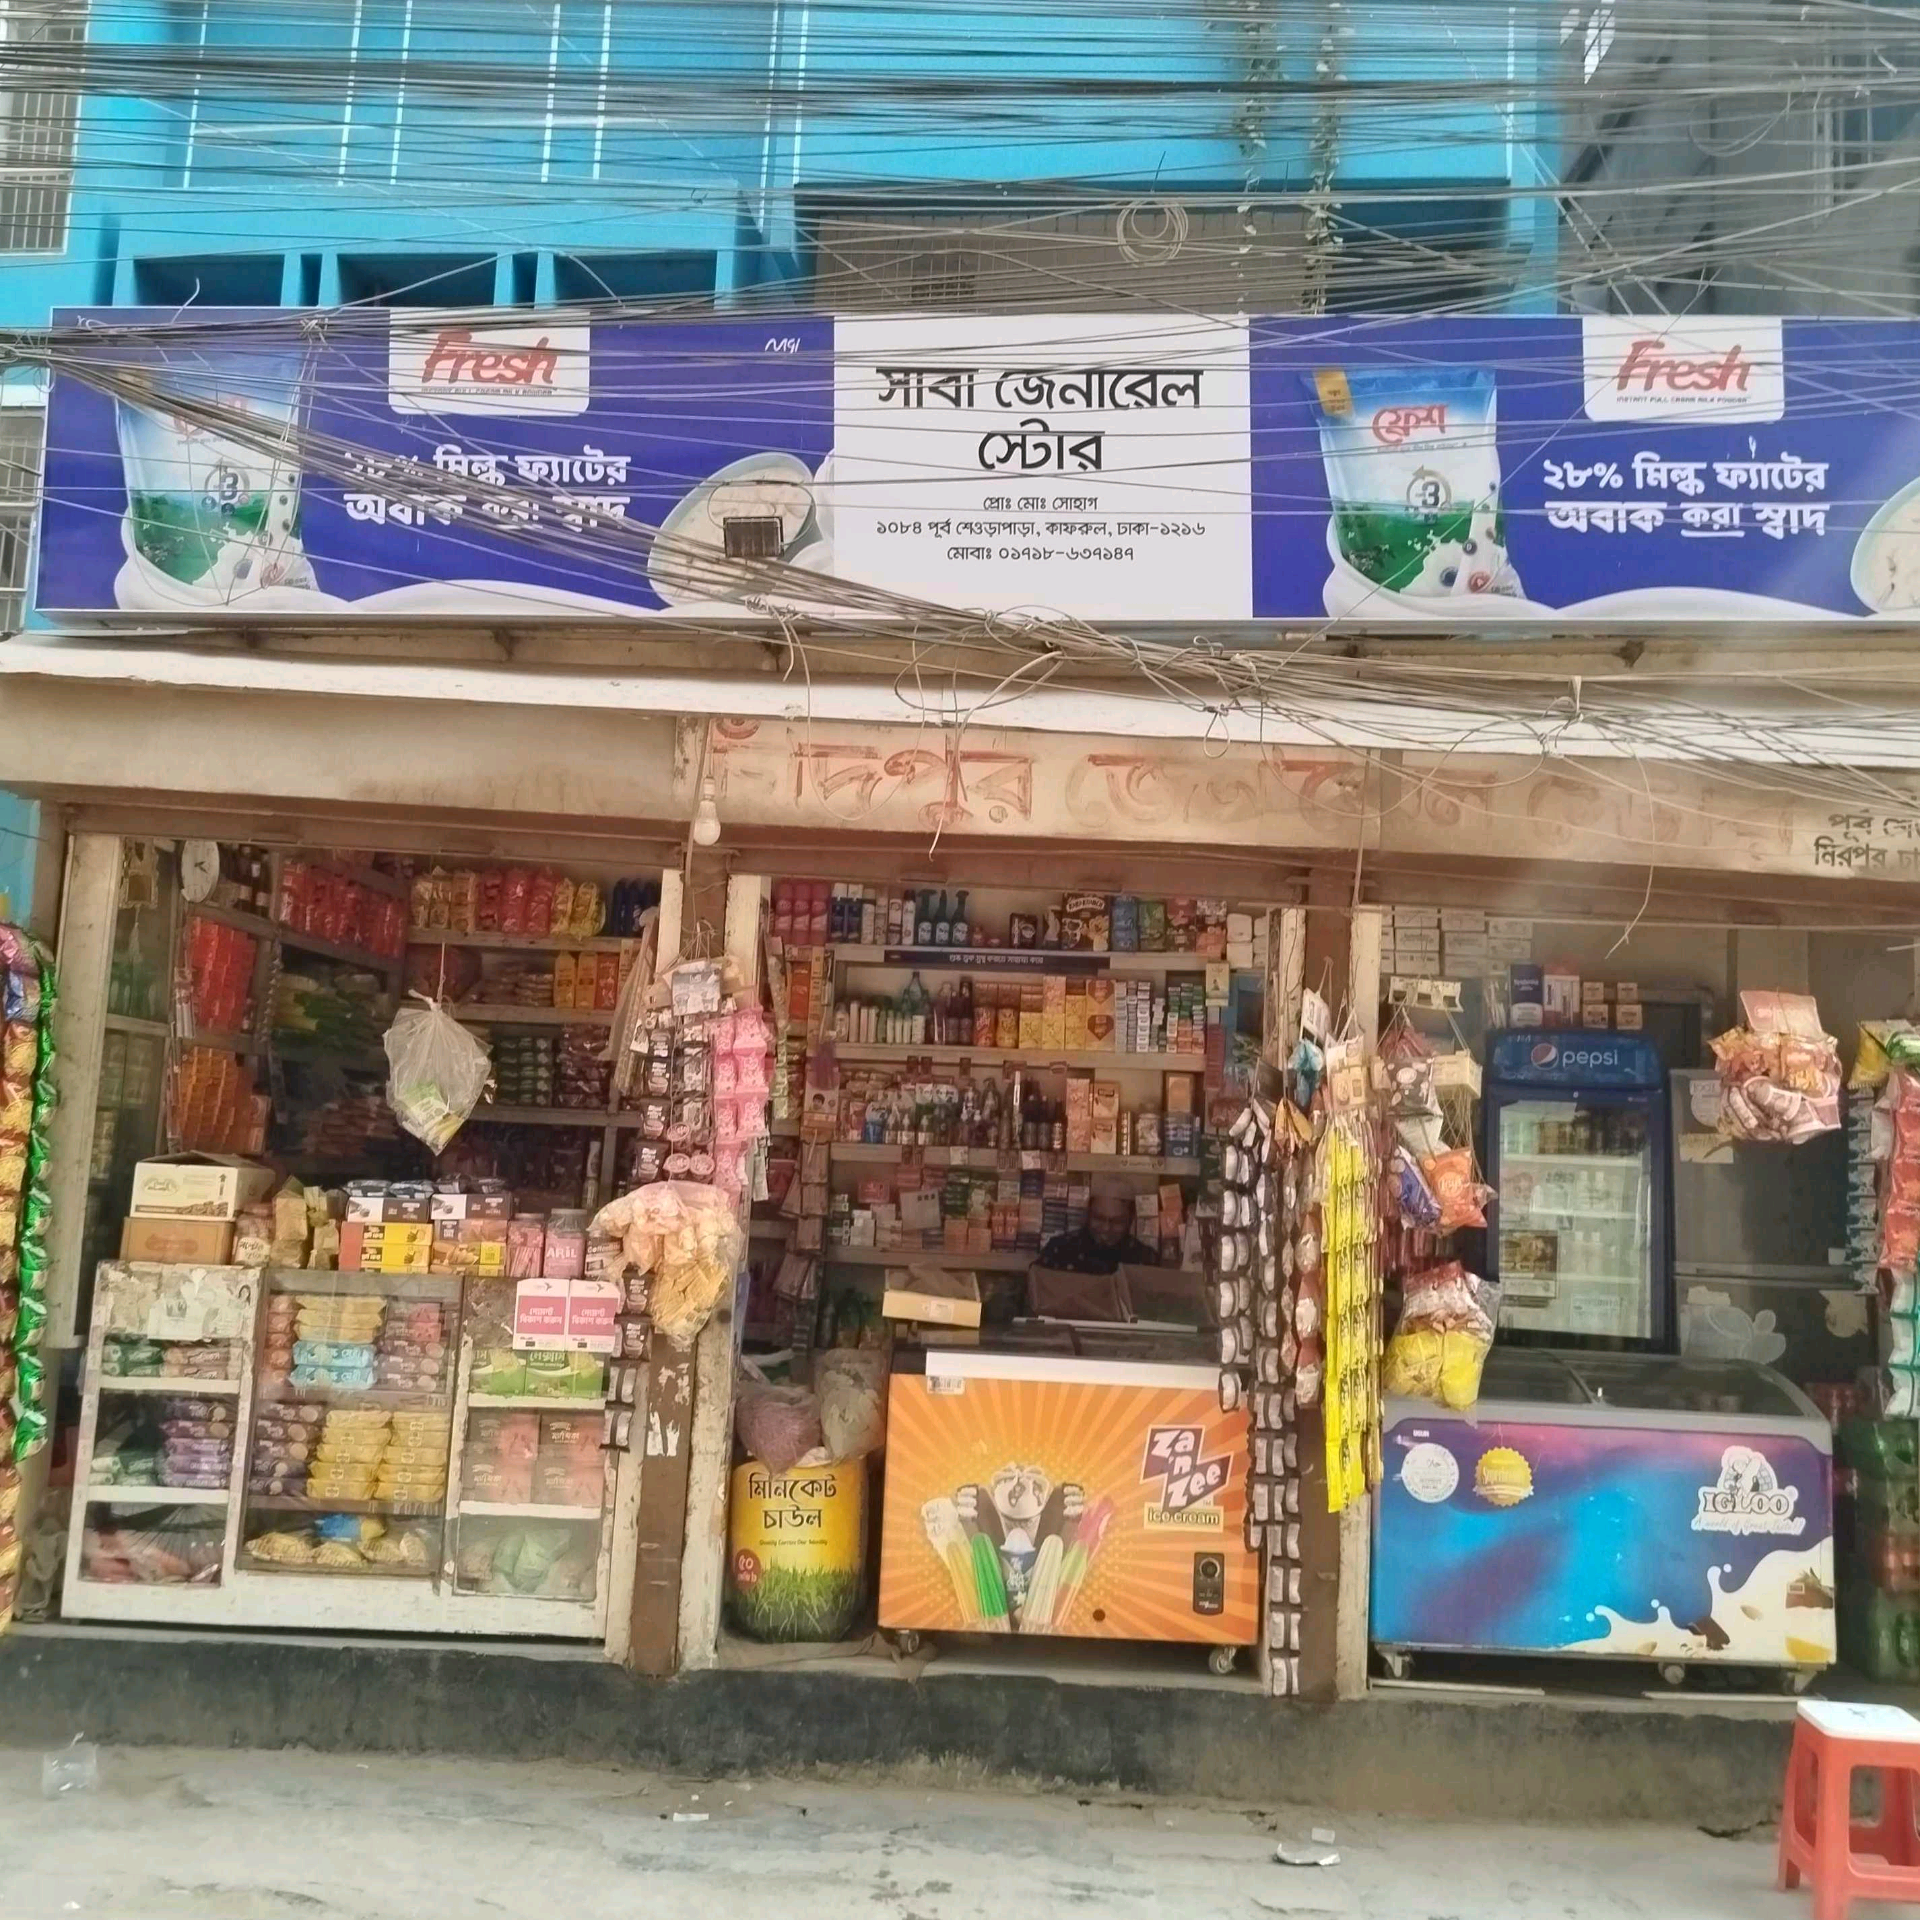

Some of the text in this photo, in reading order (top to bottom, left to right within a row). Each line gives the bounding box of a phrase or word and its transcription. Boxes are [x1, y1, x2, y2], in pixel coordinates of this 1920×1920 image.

[421, 330, 558, 384] Fresh
[1616, 340, 1752, 391] Fresh
[876, 366, 1203, 411] সাবা জেনারেল
[978, 418, 1106, 472] স্টোর
[514, 444, 632, 486] ফ্যাটের
[1543, 450, 1830, 496] ২৮% মিল্ক ফ্যাটের
[1017, 496, 1047, 511] মোঃ
[1052, 496, 1099, 512] সোহাগ
[1544, 501, 1830, 540] অবাক করা স্বাদ
[876, 522, 923, 536] ১০৮৪
[927, 517, 952, 539] পূর্ব
[1117, 521, 1206, 537] ঢাকা-১২১৬
[946, 546, 1134, 562] মোবাঃ ০১৭১৮-৬৩৭১৪৭
[1562, 1049, 1619, 1074] pepsi
[762, 1505, 824, 1530] চাউল
[1703, 1491, 1790, 1515] IGLOO
